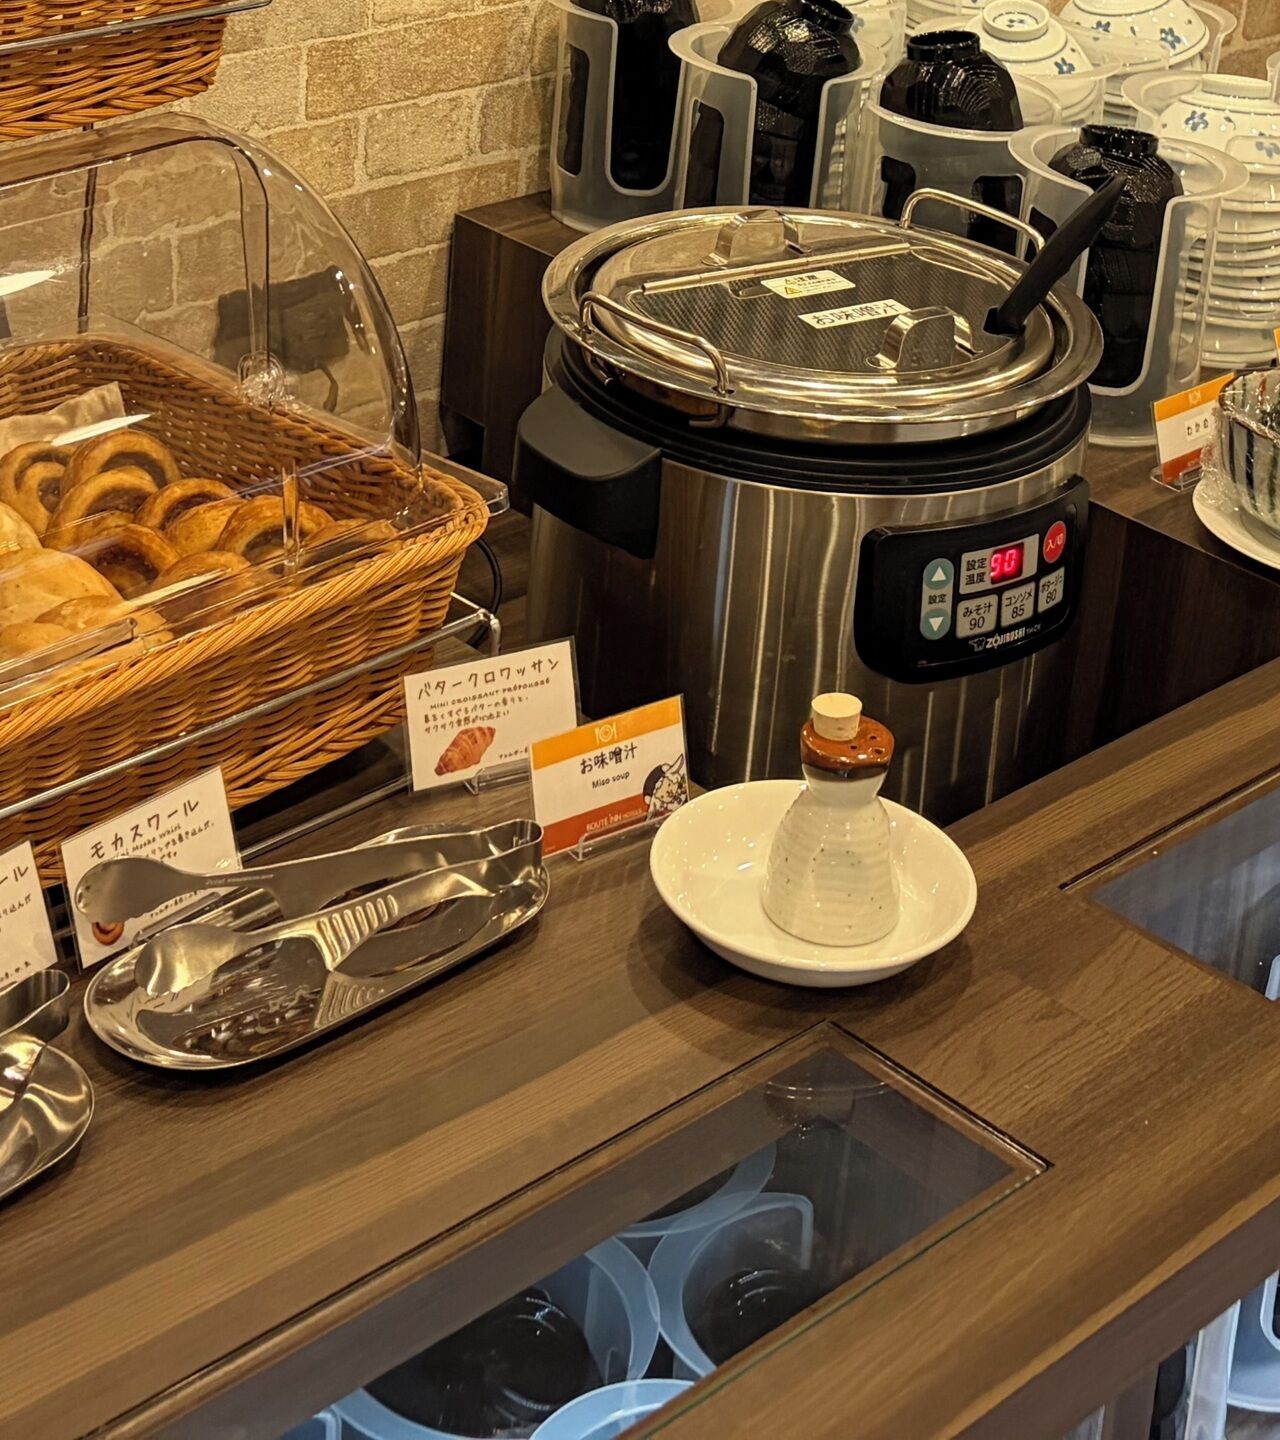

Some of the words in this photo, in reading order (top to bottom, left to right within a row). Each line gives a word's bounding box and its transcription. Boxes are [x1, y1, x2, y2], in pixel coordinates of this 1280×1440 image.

[810, 302, 901, 325] お味噌汁
[1186, 418, 1209, 436] わかめ
[966, 557, 987, 572] 設定
[990, 548, 1016, 577] 90
[965, 571, 986, 586] 温度
[928, 593, 947, 605] 設定
[1004, 588, 1033, 608] コンソメ
[1045, 590, 1058, 605] 80
[963, 603, 993, 619] みそ汁
[1011, 604, 1025, 620] 85
[969, 616, 985, 631] 90
[418, 658, 559, 700] バタークロワッサン
[430, 701, 449, 710] MINI
[451, 689, 500, 705] CROISSANT
[580, 742, 638, 775] お味噌汁
[592, 778, 610, 790] Miso
[612, 771, 630, 785] soup
[91, 799, 200, 859] モカスワール
[586, 816, 608, 832] ROUTE
